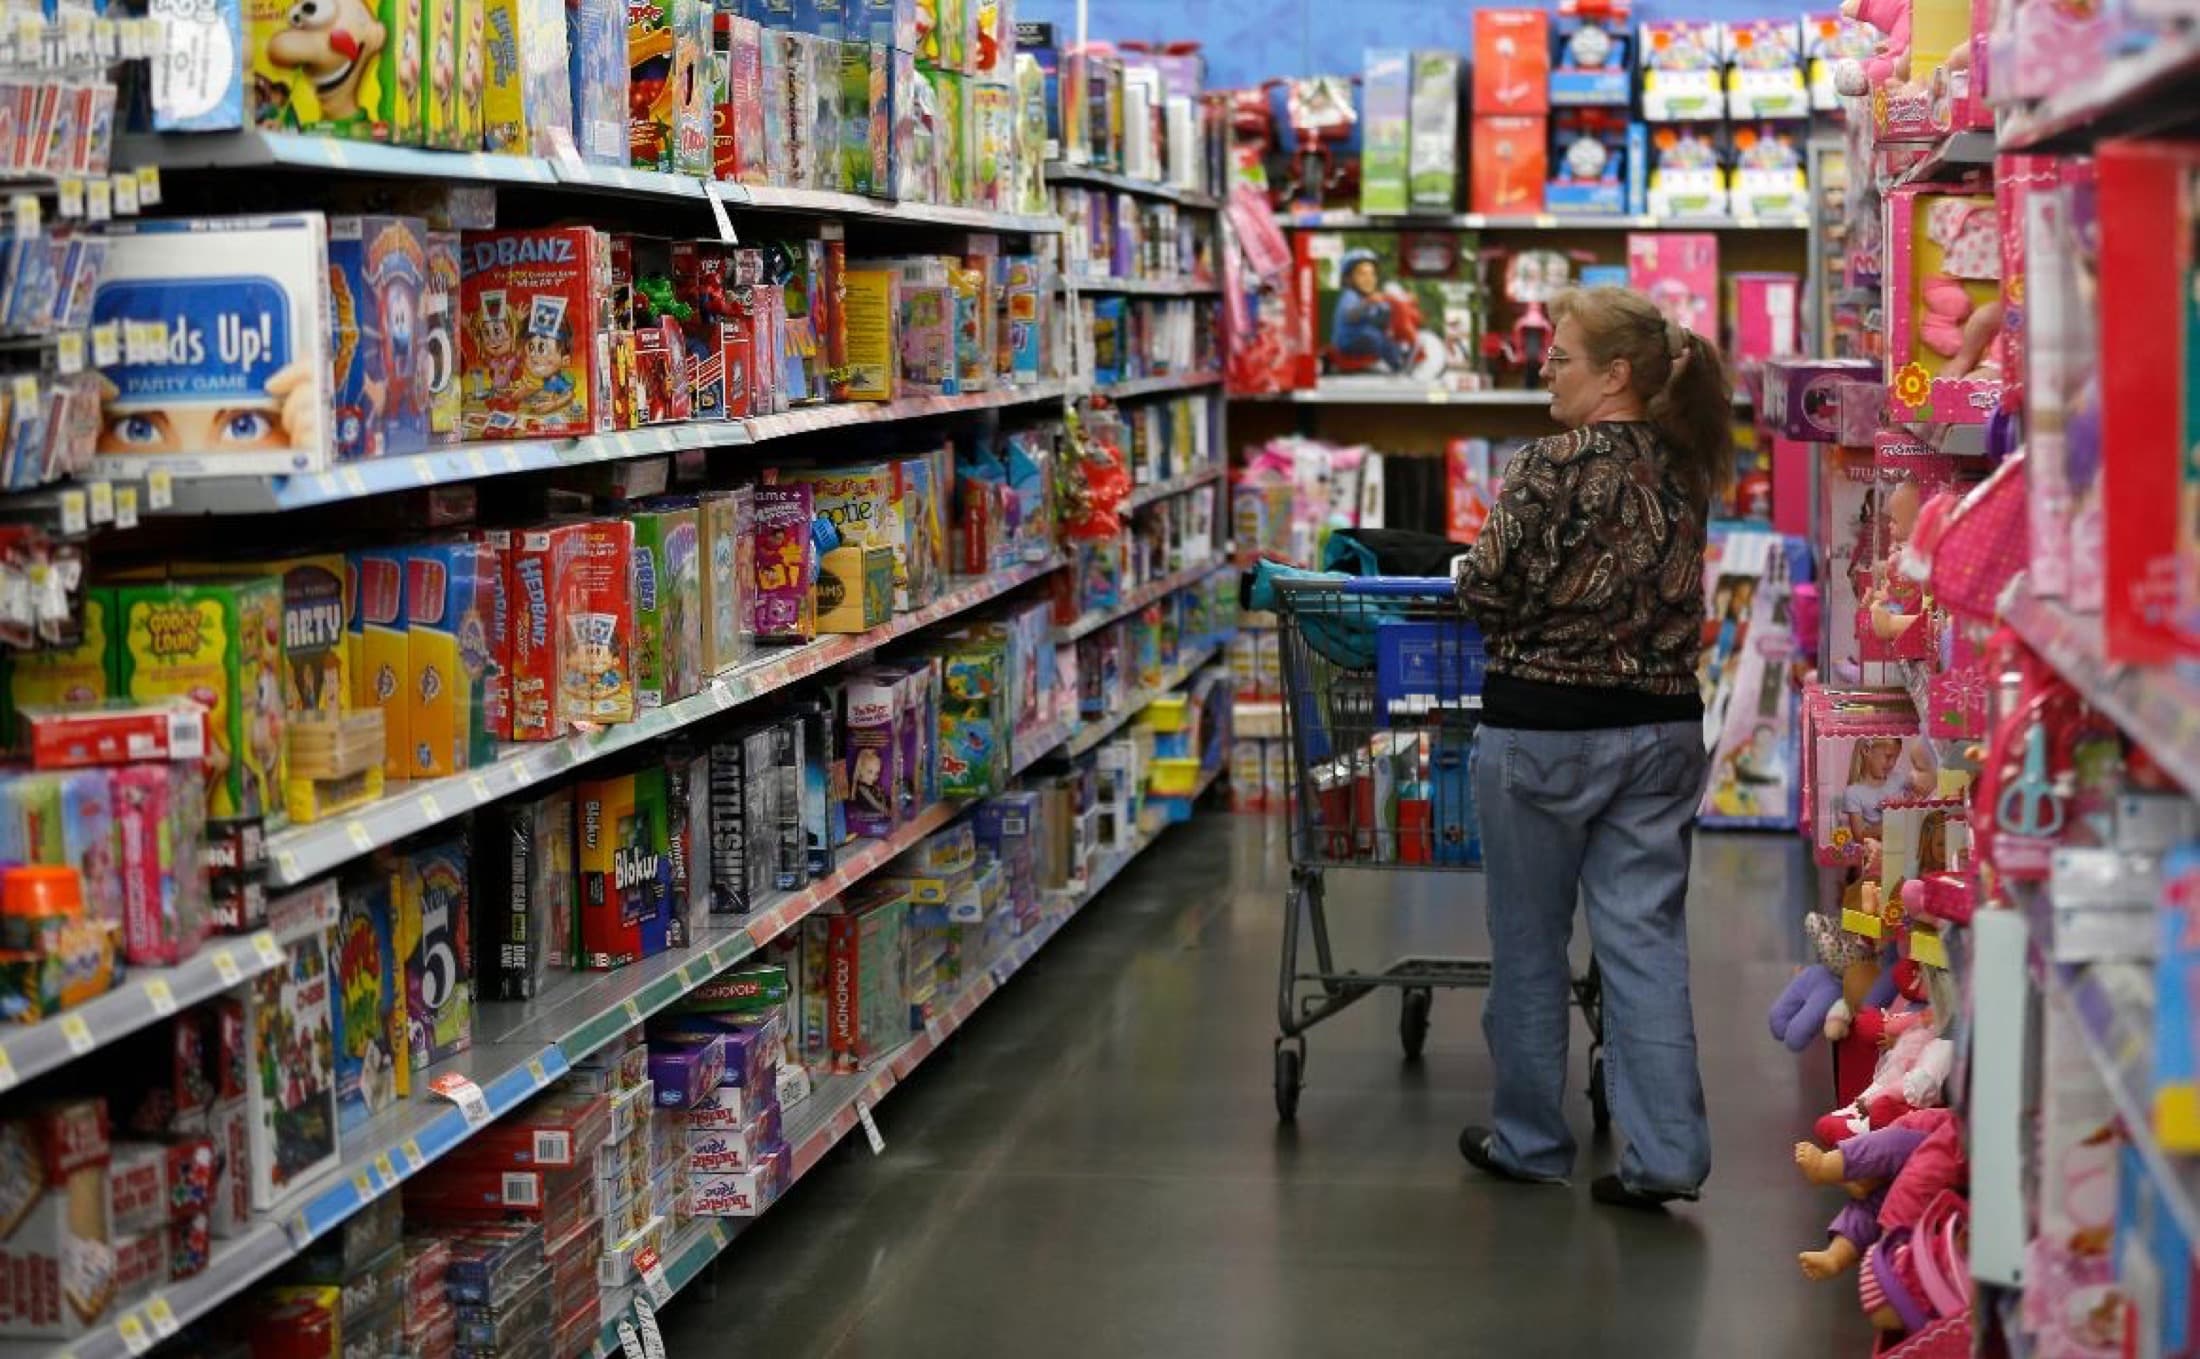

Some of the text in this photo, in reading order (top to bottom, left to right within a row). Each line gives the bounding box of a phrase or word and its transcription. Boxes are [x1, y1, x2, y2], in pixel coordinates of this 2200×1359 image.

[461, 236, 577, 279] EDBANZ
[217, 312, 273, 373] Up!
[128, 375, 248, 393] PARTY GAME
[515, 556, 548, 648] HEDBANZ
[285, 603, 341, 648] ARTY
[615, 846, 659, 890] Blokus
[512, 944, 527, 969] DICE
[832, 957, 849, 1039] MONOPOLY
[687, 1108, 738, 1127] Twiste
[690, 1150, 743, 1170] Twiste
[693, 1194, 752, 1215] Twister
